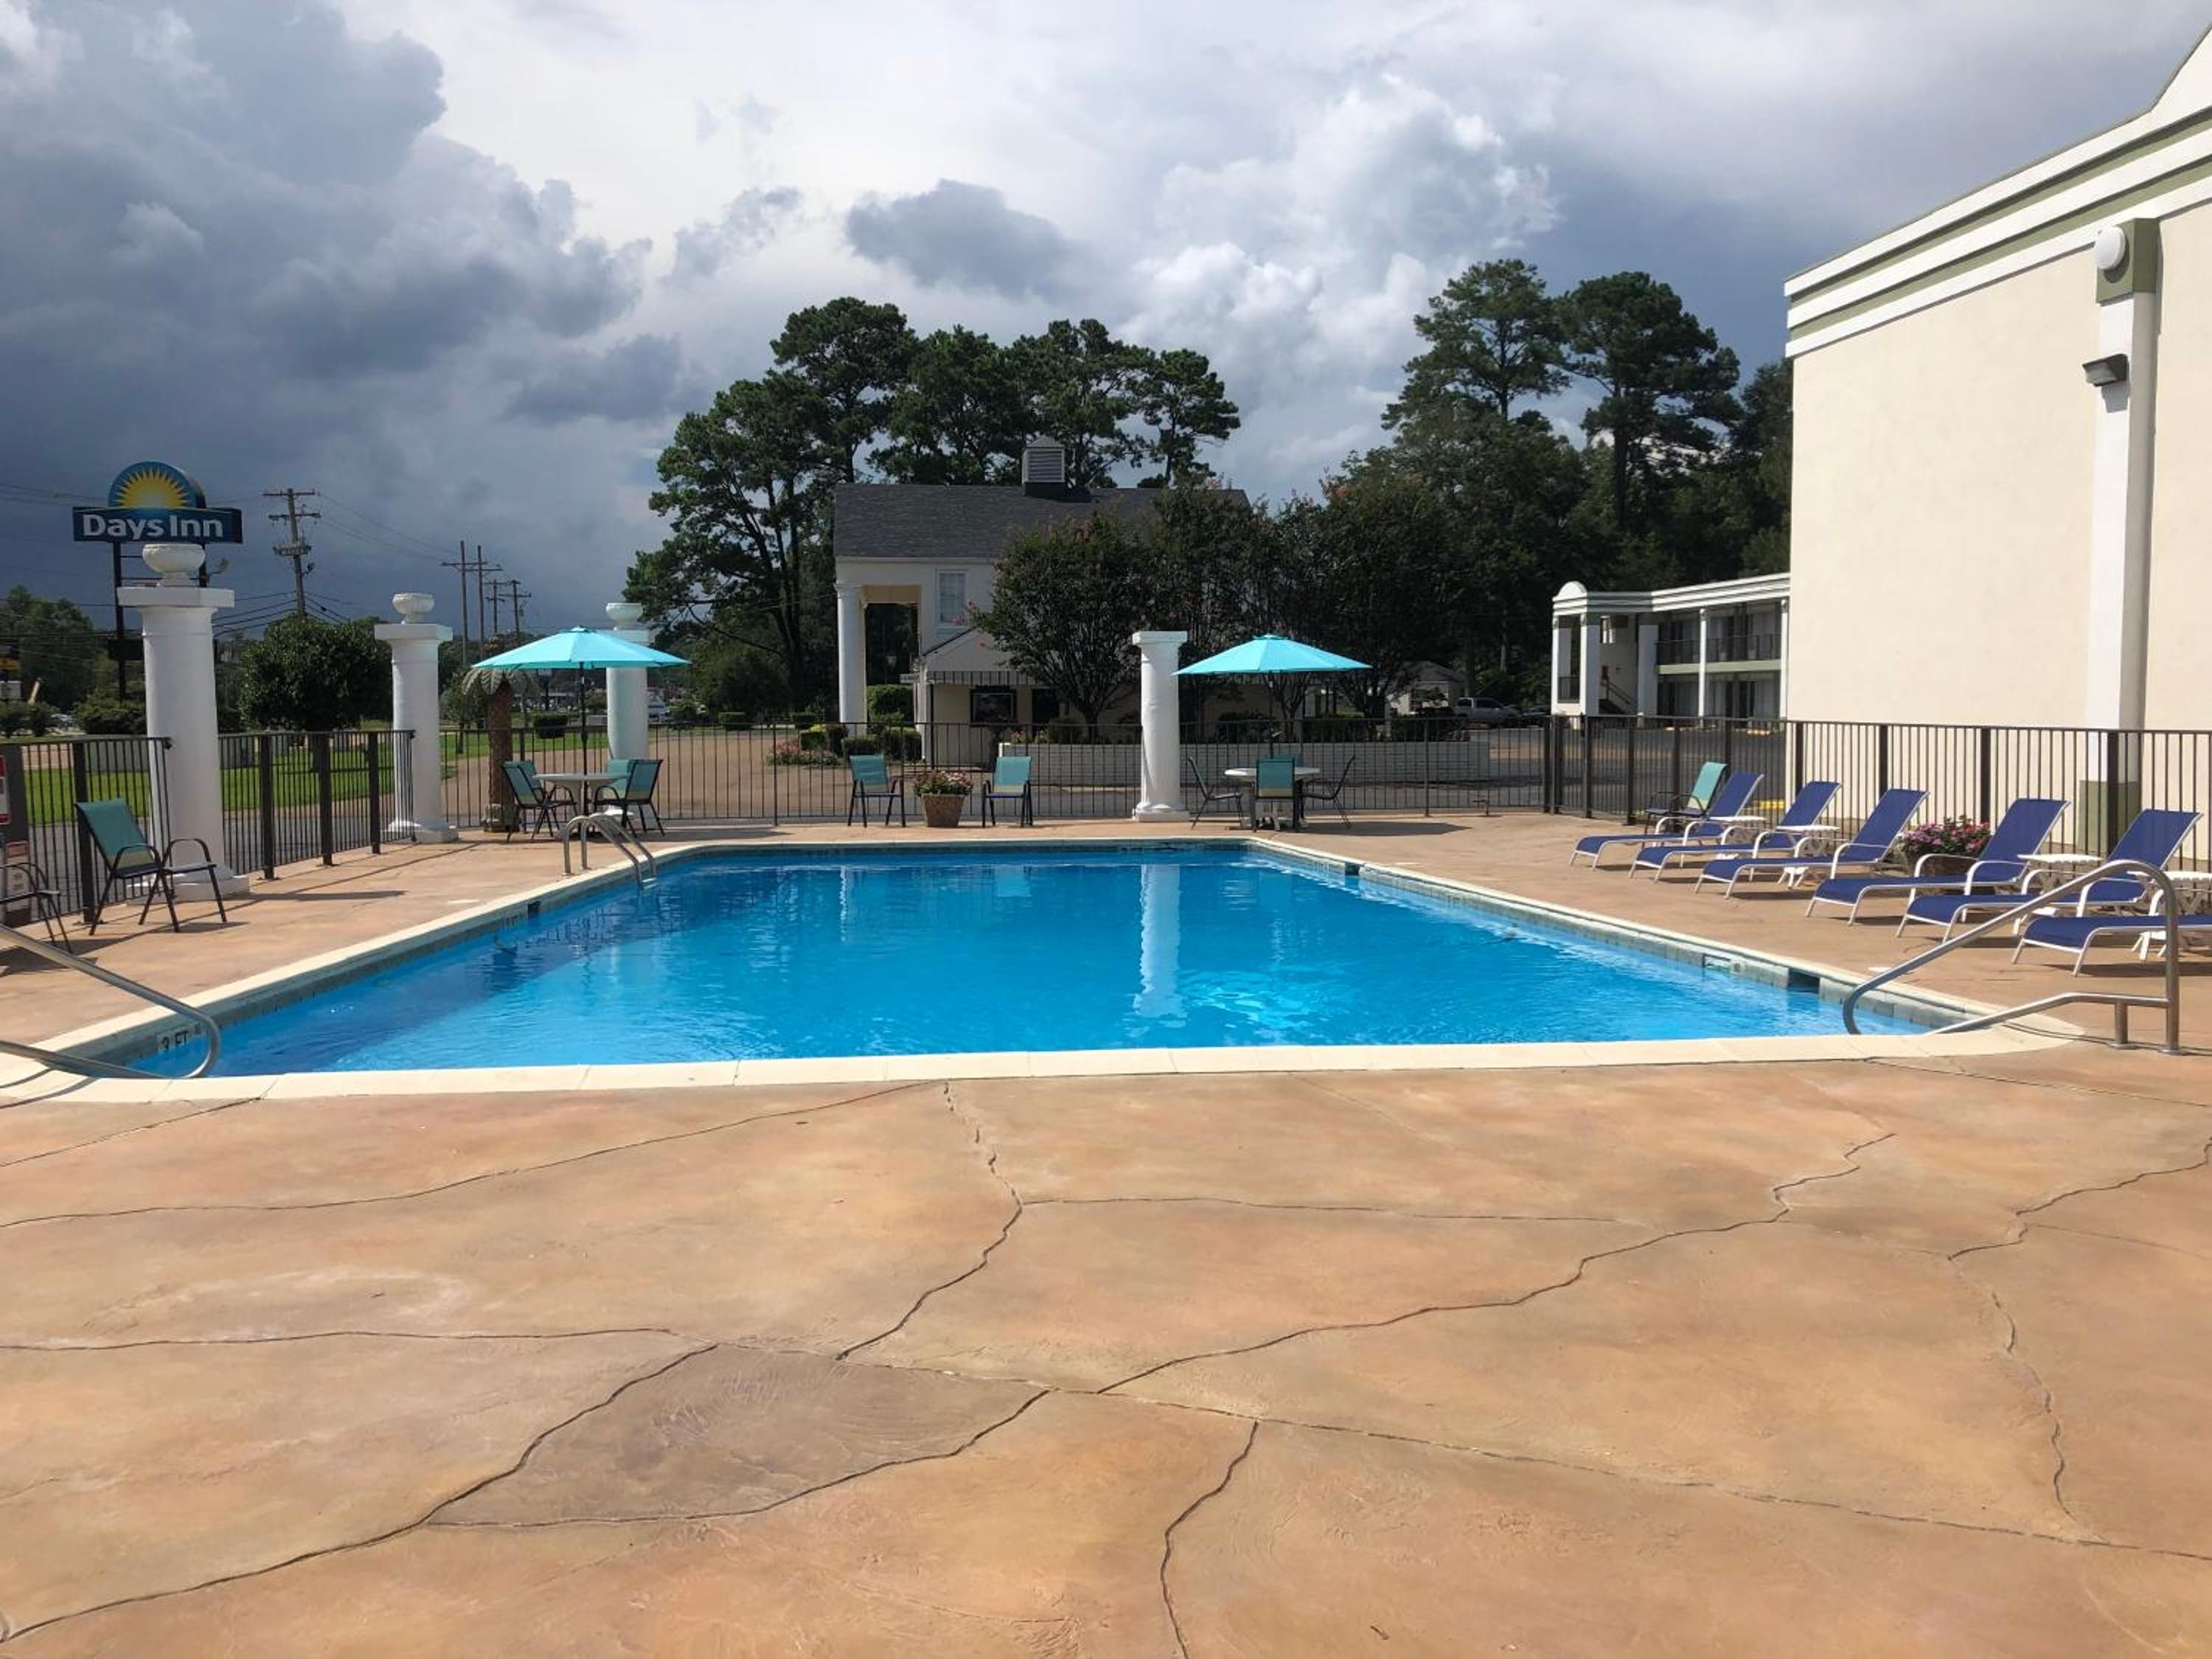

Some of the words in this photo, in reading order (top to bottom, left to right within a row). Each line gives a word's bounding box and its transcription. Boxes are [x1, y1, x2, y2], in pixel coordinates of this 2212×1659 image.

[83, 514, 163, 540] Days
[170, 515, 223, 537] Inn
[175, 1029, 189, 1046] FT
